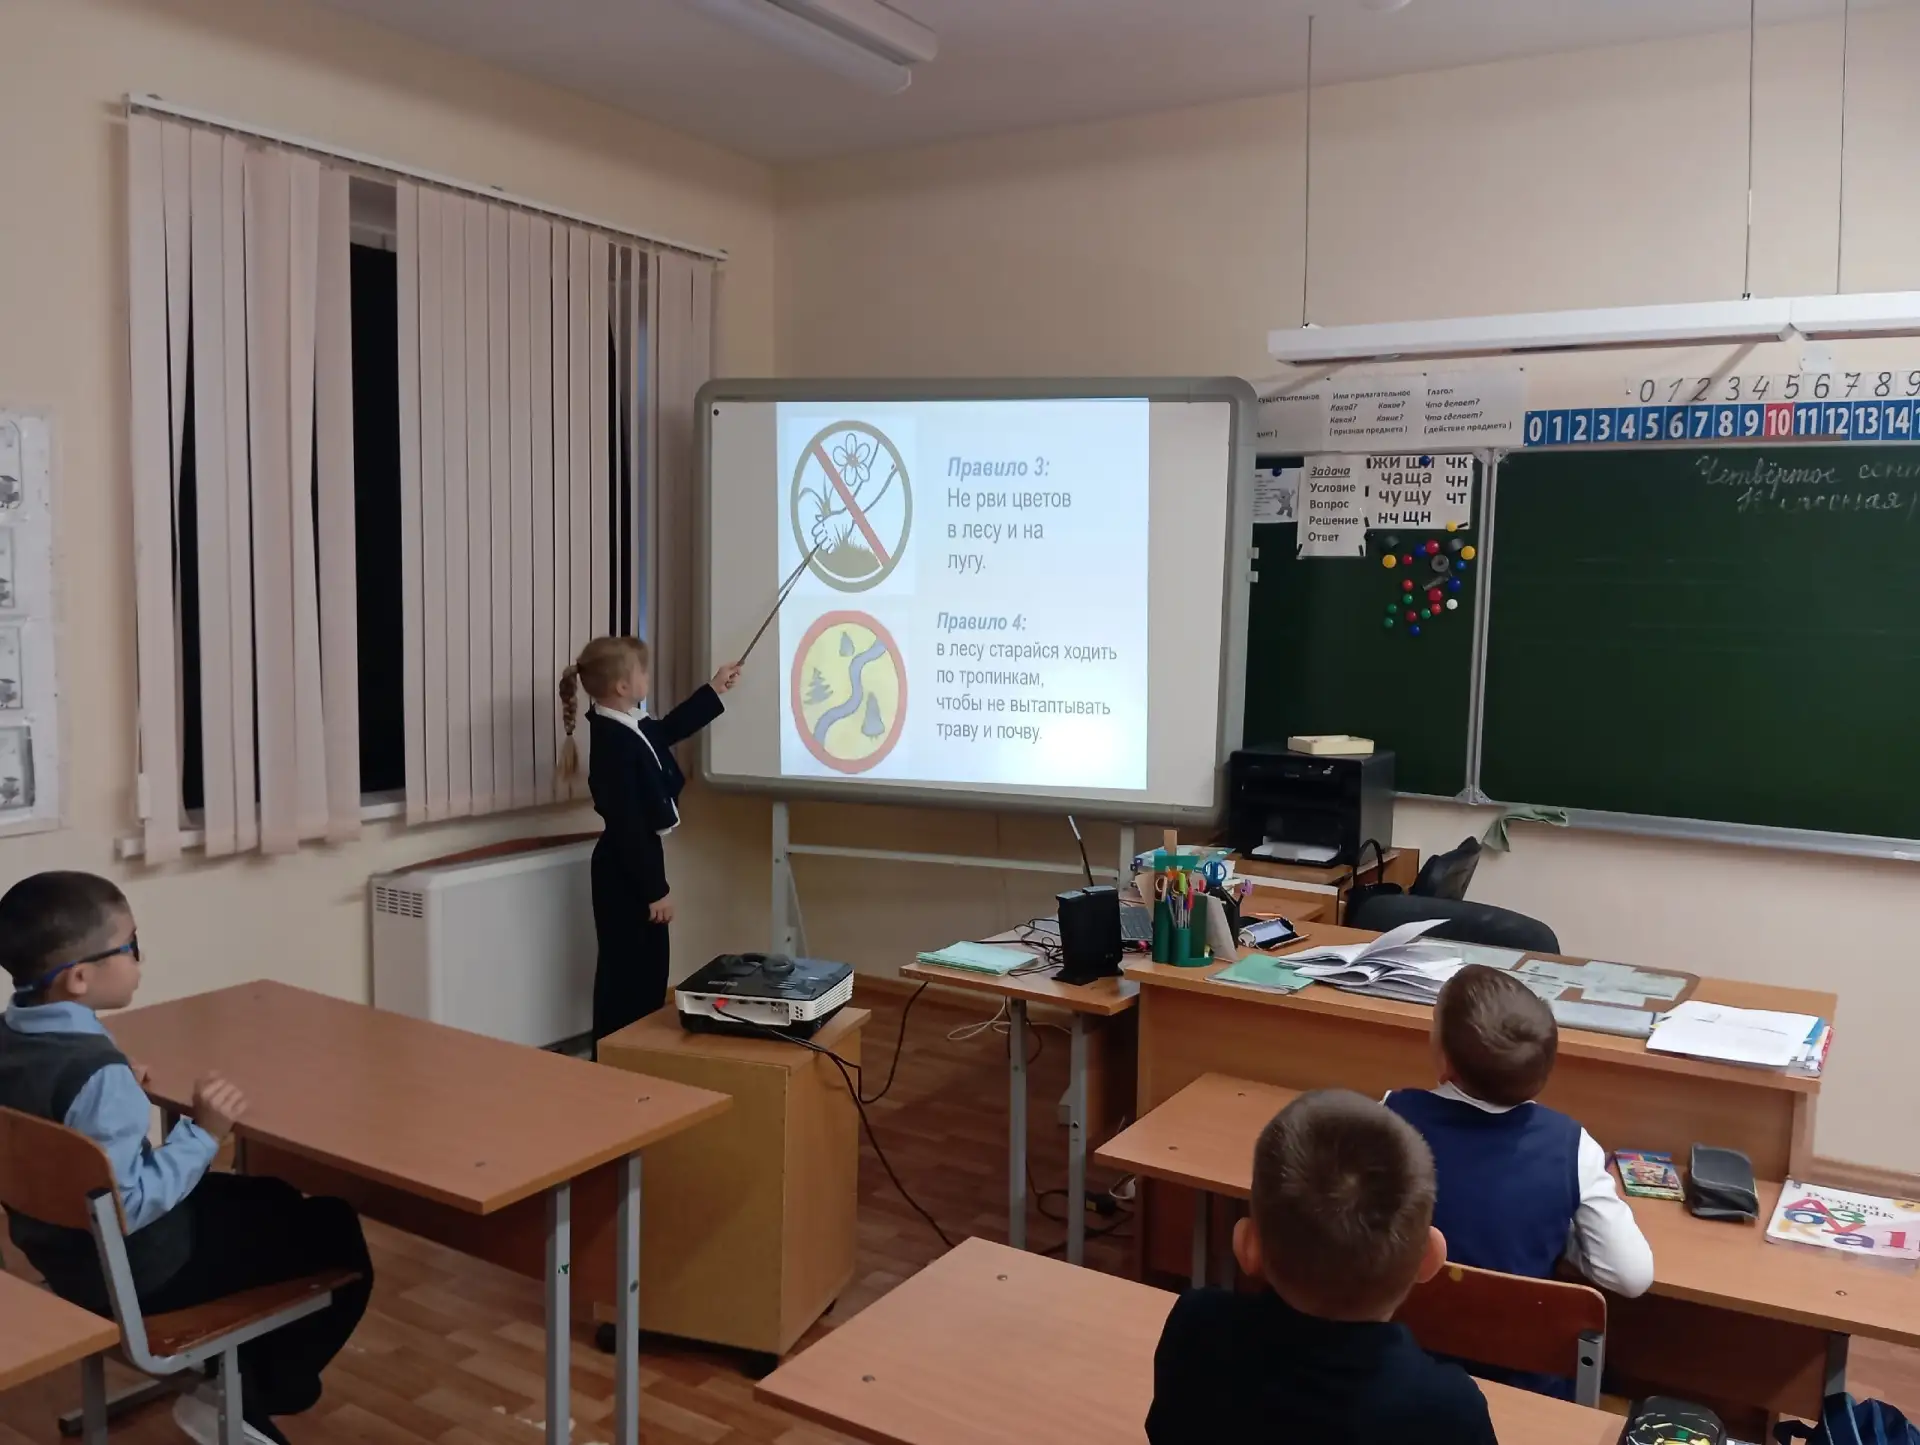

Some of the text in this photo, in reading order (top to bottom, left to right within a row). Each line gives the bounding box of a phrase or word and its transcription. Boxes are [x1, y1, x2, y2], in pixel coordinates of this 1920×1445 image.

[1640, 371, 1920, 402] 0 1 2 3 4 5 6 7 8 9
[1378, 401, 1405, 409] Какое?
[1444, 398, 1480, 407] делает?
[1376, 414, 1404, 422] Какие?
[1444, 411, 1483, 420] сделает?
[1529, 417, 1542, 441] 0
[1553, 416, 1562, 440] 1
[1574, 415, 1587, 440] 2
[1597, 414, 1610, 440] 3
[1621, 414, 1635, 439] 4
[1645, 413, 1659, 439] 5
[1669, 412, 1684, 438] 6
[1695, 412, 1708, 437] 7
[1718, 410, 1733, 436] 8
[1744, 411, 1759, 435] 9
[1768, 409, 1790, 436] 10
[1797, 408, 1818, 434] 11
[1826, 408, 1848, 434] 12
[1855, 407, 1878, 434] 13
[1886, 407, 1909, 434] 14
[948, 456, 1050, 482] Правило 3:
[1310, 467, 1350, 476] Задача
[1310, 483, 1356, 493] Условие
[1446, 476, 1468, 487] чн
[948, 489, 1071, 514] Не рви цветов
[1446, 492, 1466, 504] чт
[1310, 500, 1349, 511] Вопрос
[1309, 516, 1359, 525] Решение
[1378, 511, 1431, 525] нч щн
[948, 523, 1044, 545] в лесу и на
[1308, 532, 1339, 542] Ответ
[947, 553, 987, 574] лугу.
[937, 613, 1027, 634] Правило 4:
[937, 642, 1117, 664] в лесу старайся ходить
[937, 669, 1044, 689] по тропинкам,
[937, 694, 1111, 718] чтобы не вытаптывать
[937, 722, 1042, 744] траву и почву.
